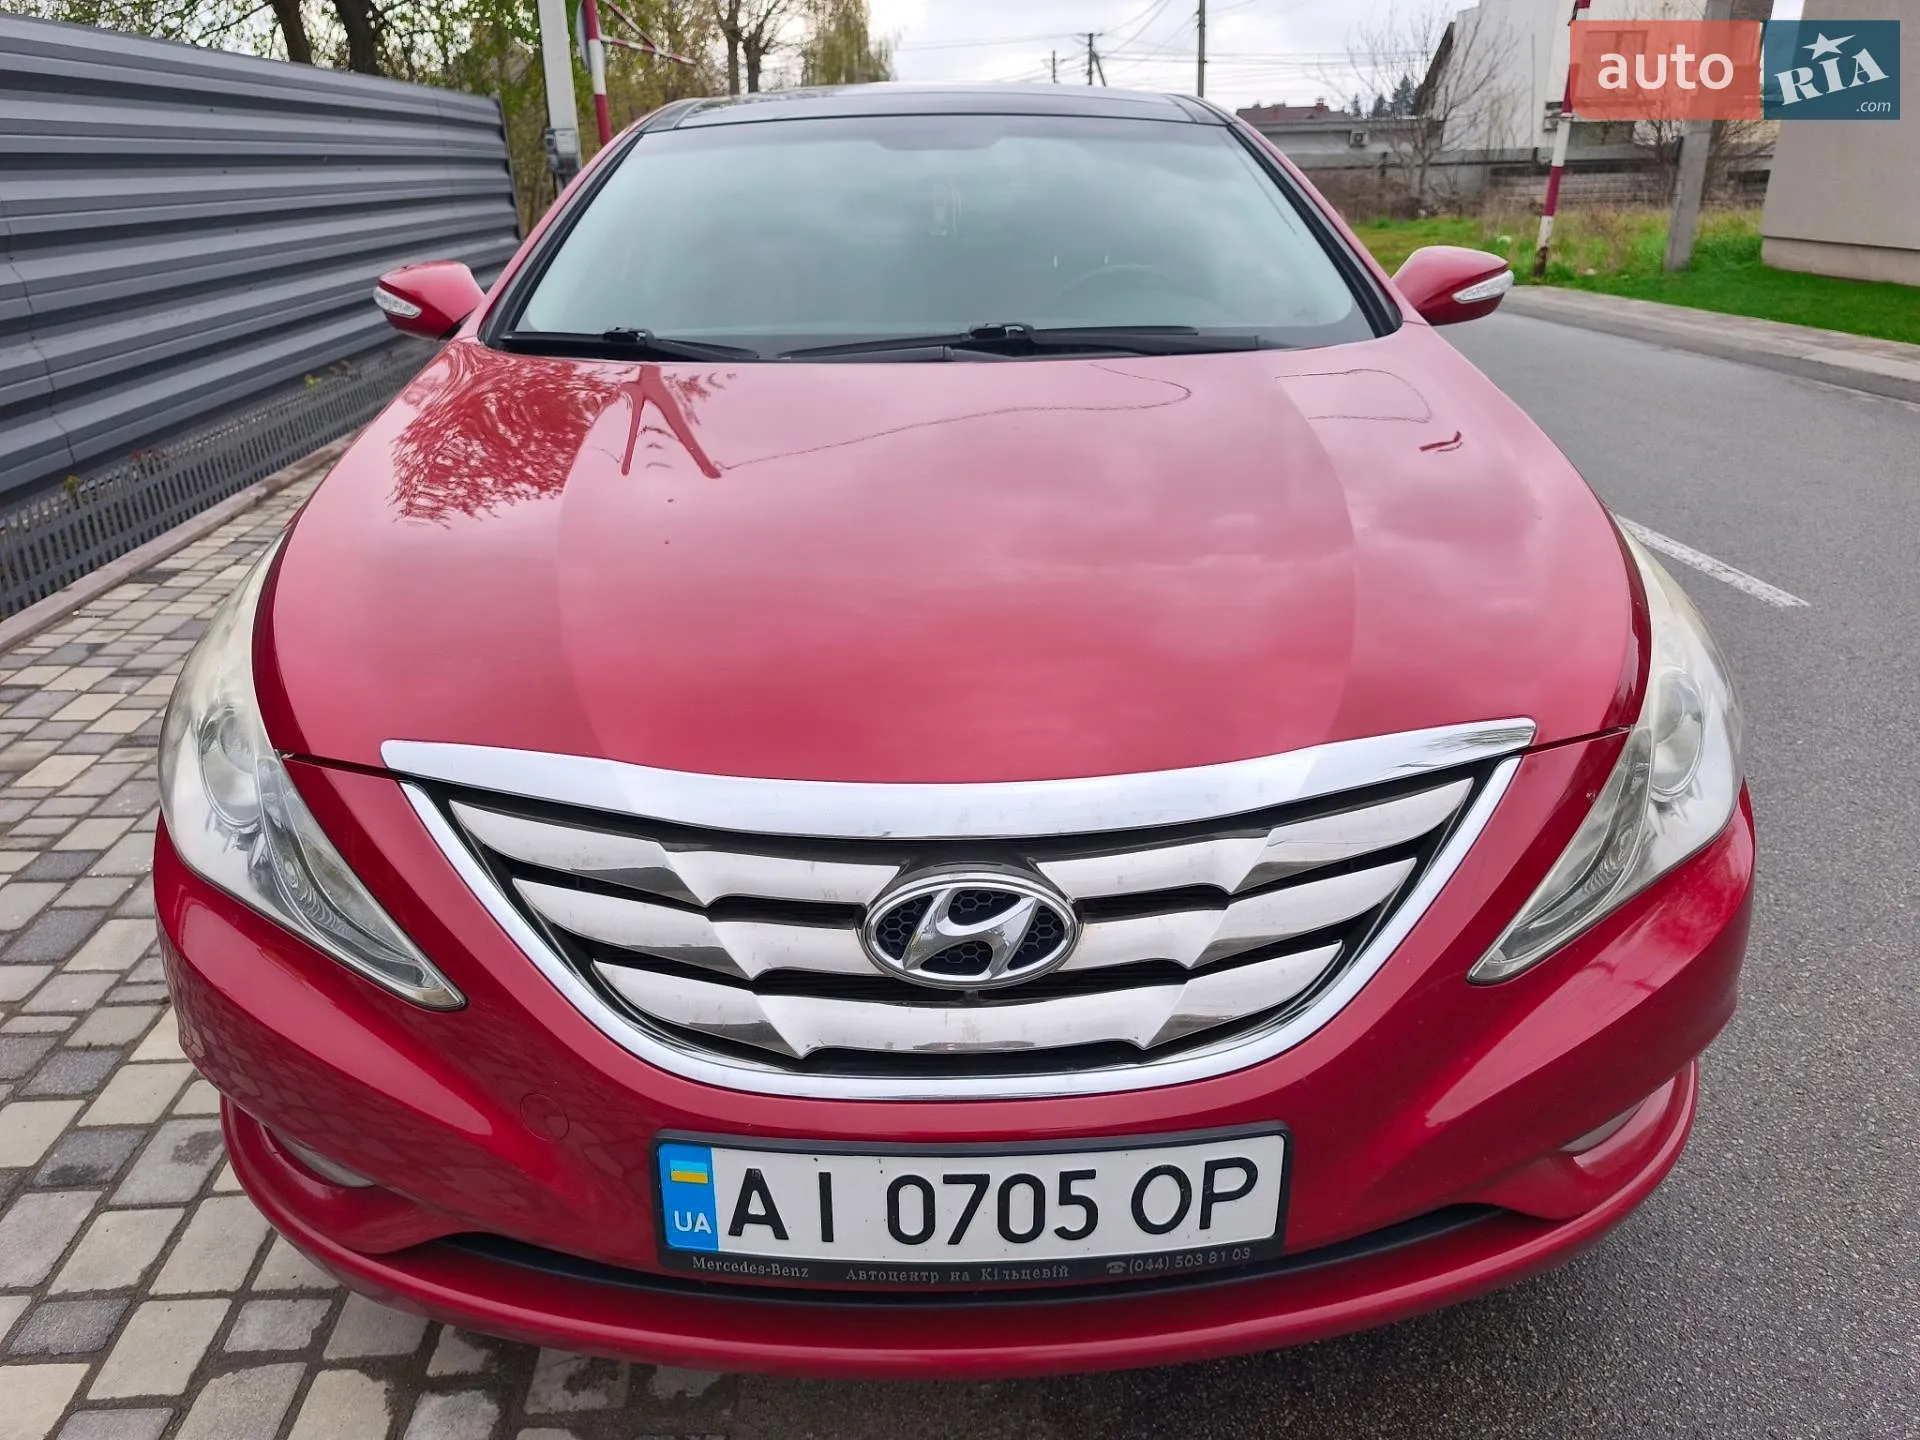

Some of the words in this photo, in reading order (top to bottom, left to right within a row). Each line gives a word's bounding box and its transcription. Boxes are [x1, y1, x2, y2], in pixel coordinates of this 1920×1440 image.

[728, 1167, 834, 1243] AI
[886, 1169, 1099, 1246] 0705
[1130, 1156, 1259, 1235] OP
[674, 1210, 712, 1234] UA
[692, 1256, 809, 1278] Mercedes-Benz
[1129, 1256, 1170, 1274] (044)
[1174, 1253, 1203, 1269] 503
[1207, 1250, 1227, 1266] 81
[846, 1268, 940, 1284] Автоцентр
[950, 1269, 970, 1282] на
